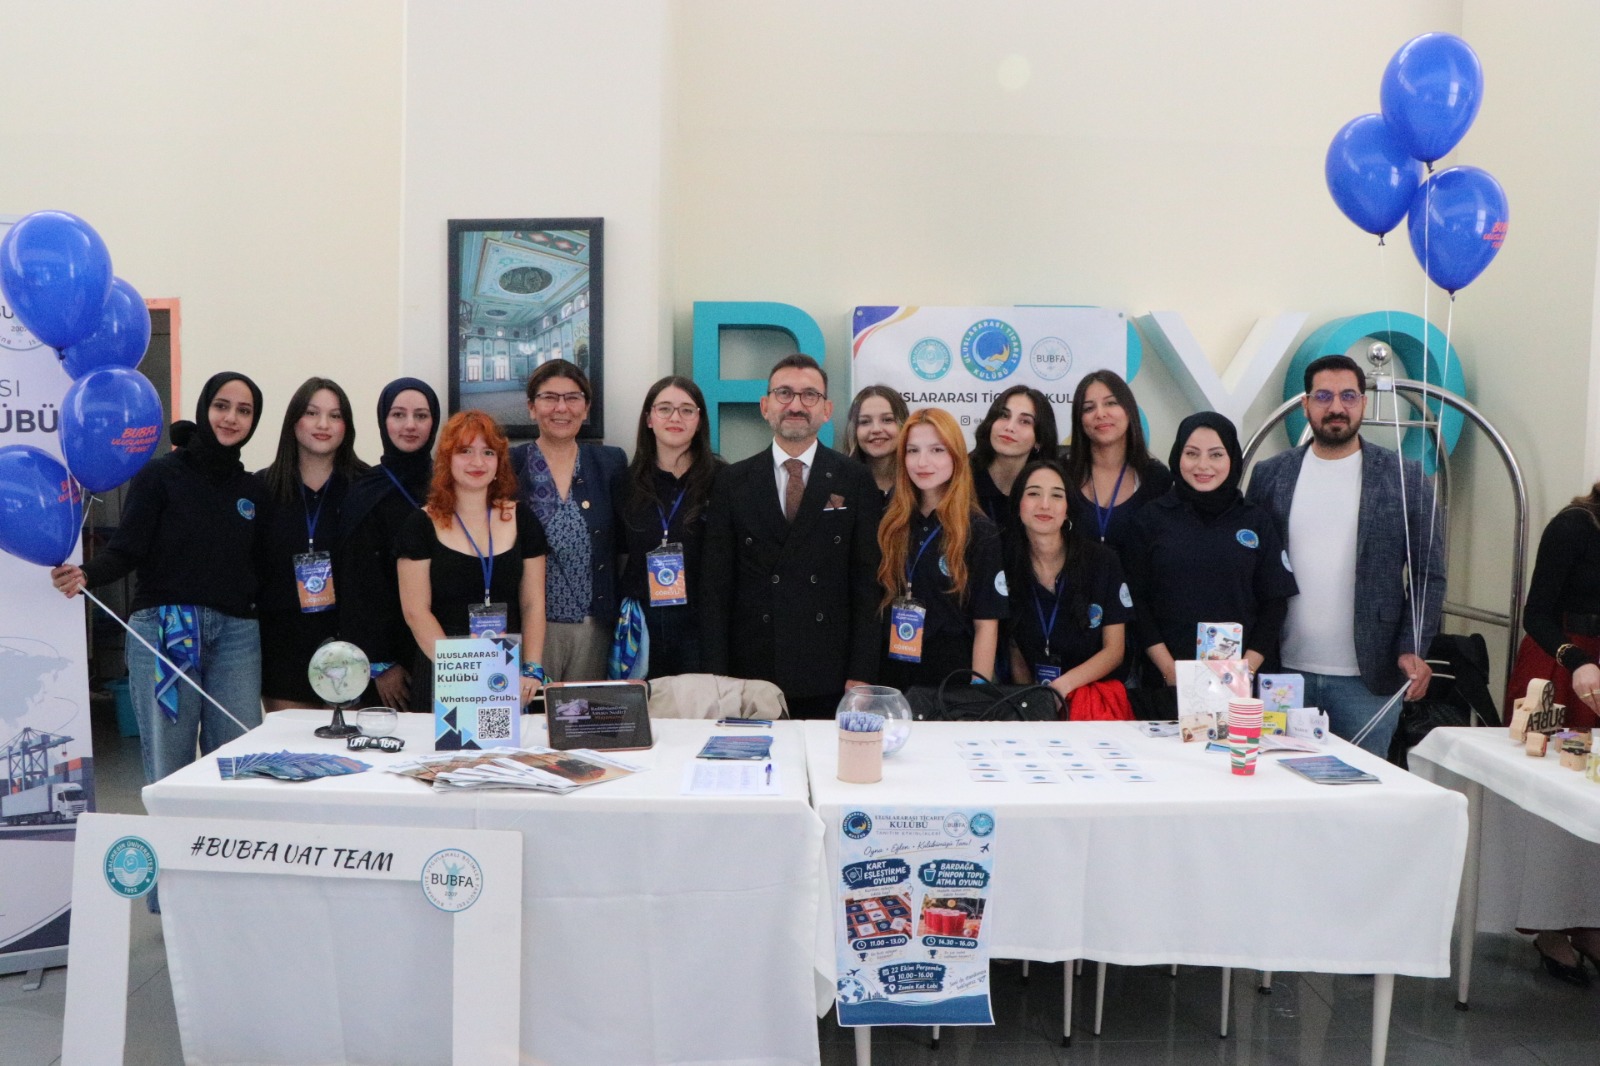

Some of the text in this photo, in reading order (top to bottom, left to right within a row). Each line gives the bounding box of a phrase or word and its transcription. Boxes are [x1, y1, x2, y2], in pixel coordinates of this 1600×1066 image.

[962, 320, 1004, 364] ULUSLARARASI
[1036, 354, 1067, 364] BUBFA
[973, 367, 1009, 380] KULÜBÜ
[436, 651, 499, 659] ULUSLARARASI
[437, 661, 482, 670] TİCARET
[437, 673, 479, 683] Kulübü
[440, 695, 487, 704] Whatsapp
[889, 820, 929, 829] KULÜBÜ
[190, 835, 394, 873] #BUBFA UAT TEAM
[866, 861, 887, 870] KART
[940, 862, 975, 871] BARDAĞA
[863, 866, 907, 880] EŞLEŞTİRME
[431, 872, 474, 888] BUBFA
[873, 876, 899, 885] OYUNU
[958, 879, 984, 887] OYUNU
[869, 939, 885, 947] 11.00
[890, 938, 906, 946] 13.00
[959, 940, 976, 948] 16.00
